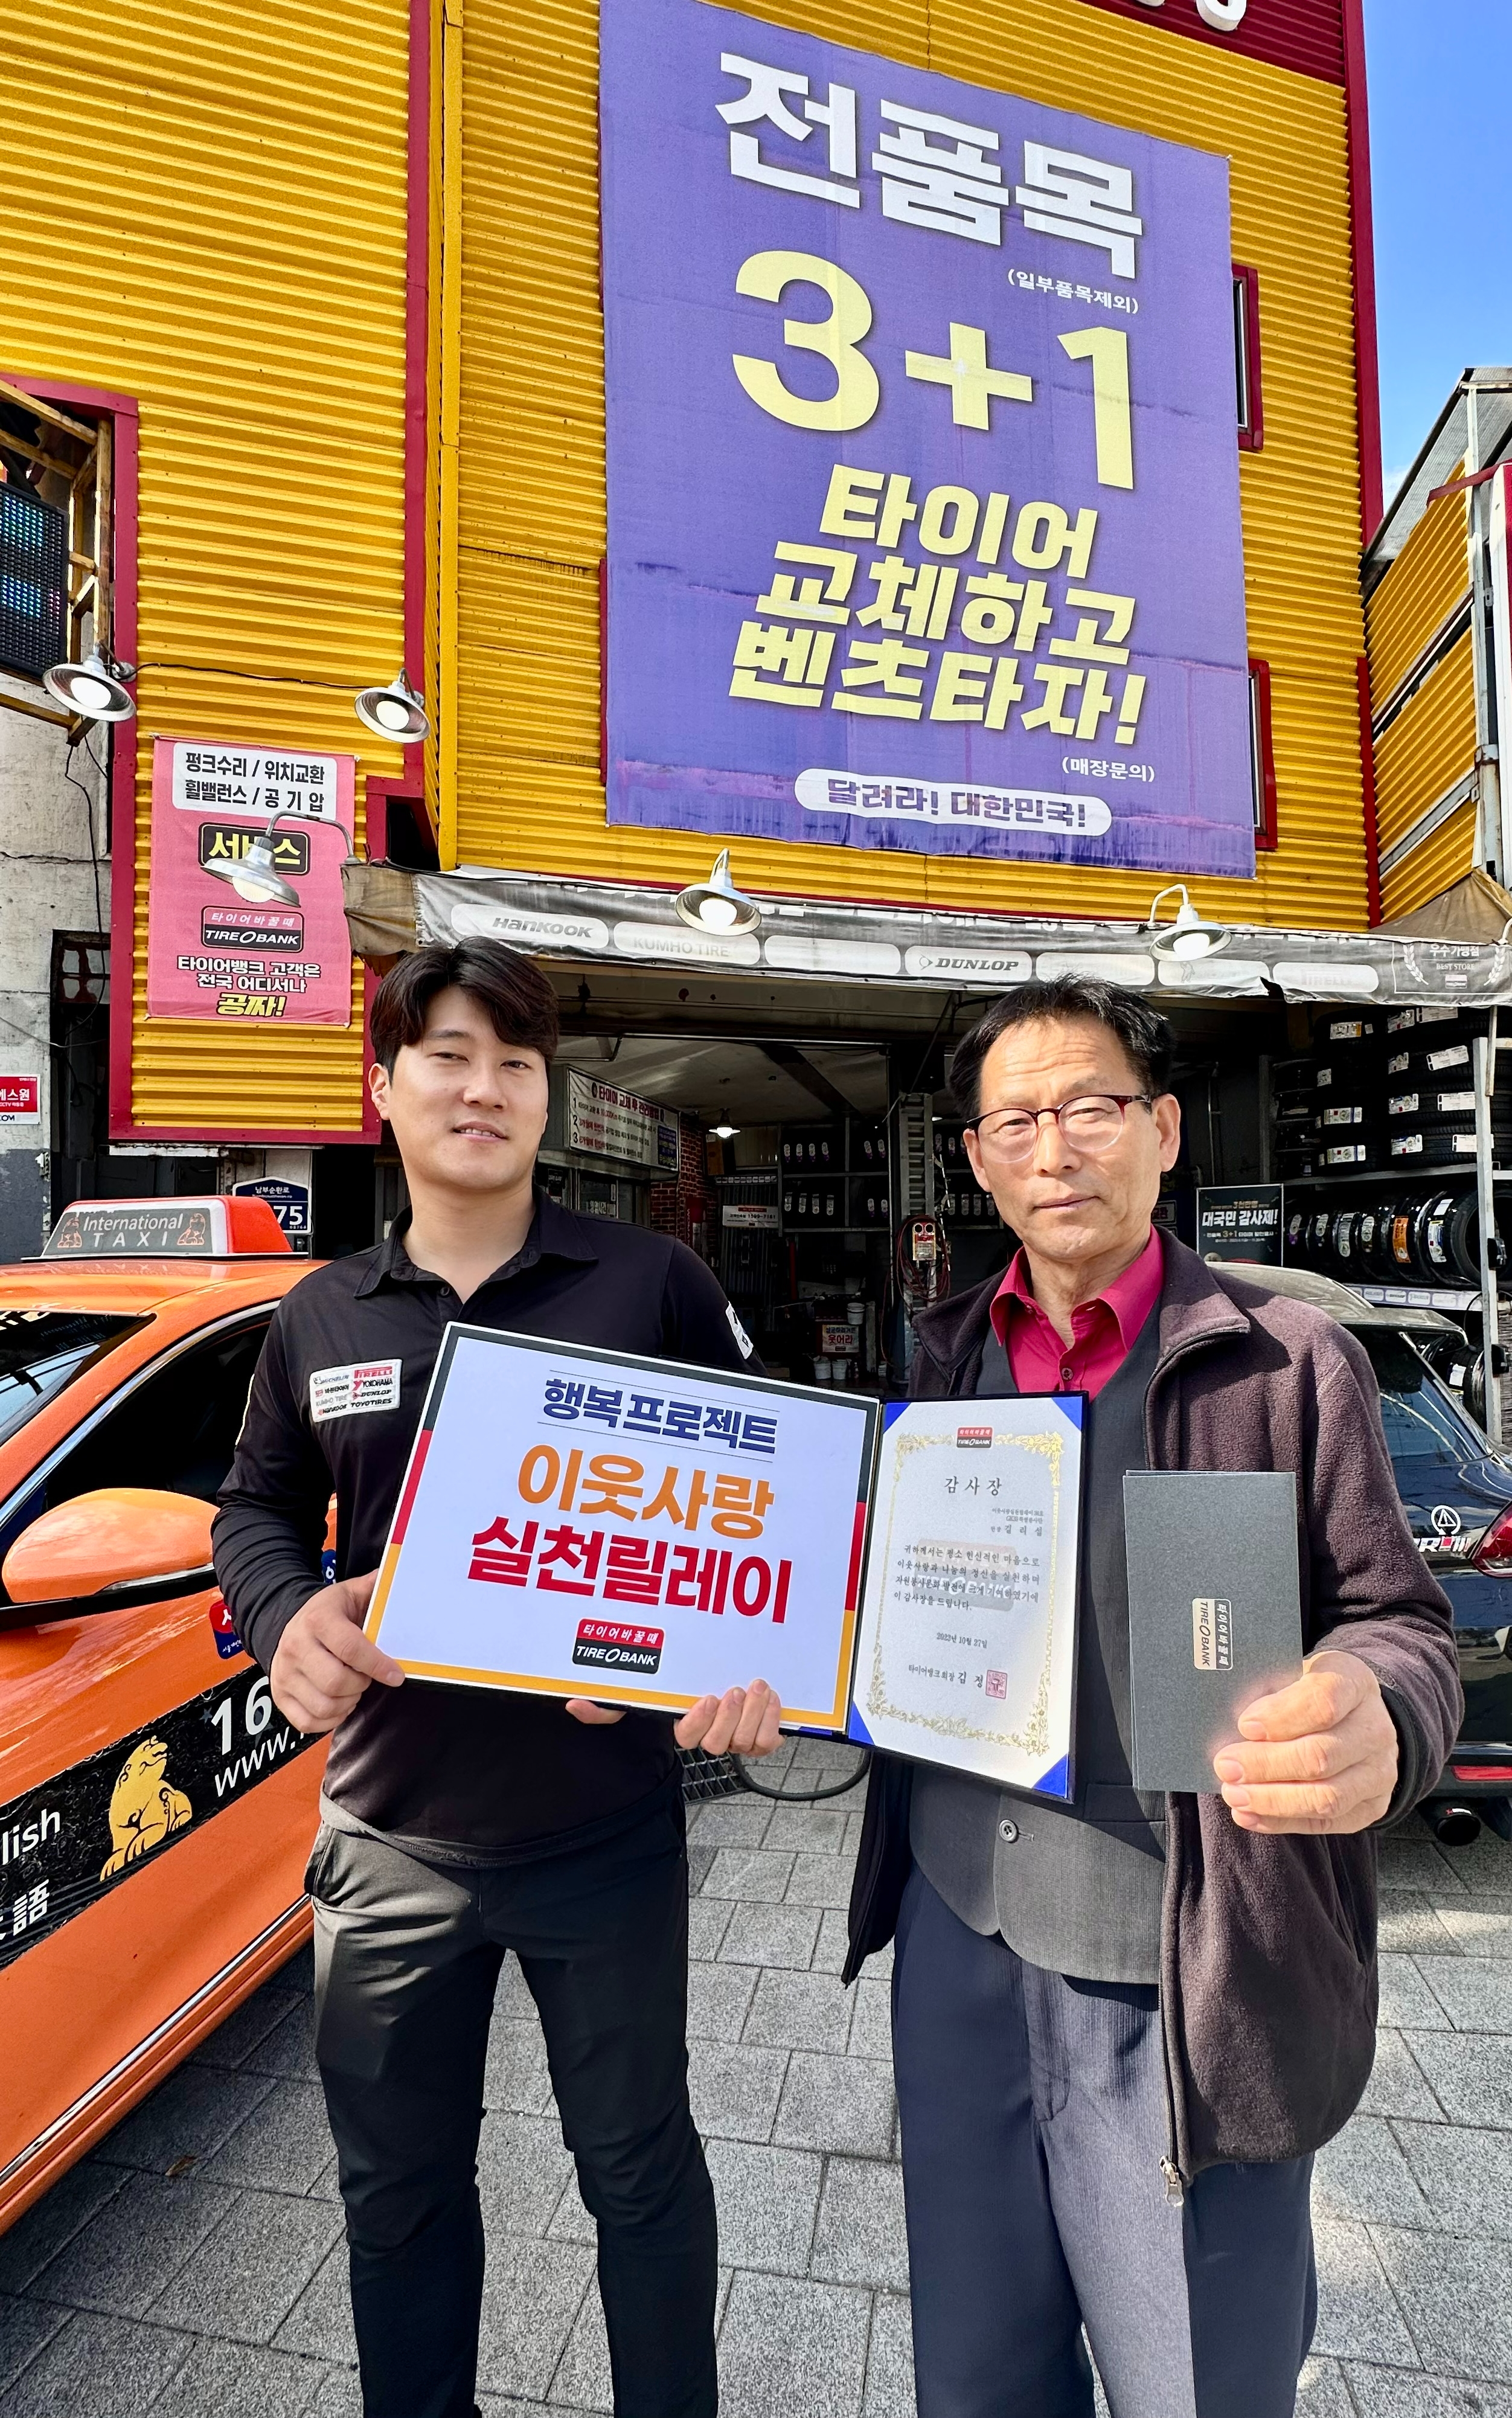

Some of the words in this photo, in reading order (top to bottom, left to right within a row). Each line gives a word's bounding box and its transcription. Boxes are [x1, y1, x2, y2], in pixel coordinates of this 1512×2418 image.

[715, 52, 1142, 278] 전품목
[1008, 269, 1138, 314] (일부품목제외)
[731, 250, 1133, 490] 3+1
[819, 463, 1098, 579] 타이어
[755, 540, 1135, 665] 교체하고
[729, 620, 1146, 744] 벤츠타자!
[186, 752, 247, 778] 펑크수리
[264, 763, 324, 785] 위치교환
[1062, 757, 1155, 783] (매장문의)
[185, 779, 247, 805] 휠밸런스
[827, 778, 938, 815] 달려라!
[951, 789, 1086, 827] 대한민국!
[209, 831, 302, 865] 서스
[633, 936, 693, 954] KUMHO
[697, 940, 729, 958] TIRE
[178, 956, 264, 975] 타이어뱅크
[270, 962, 321, 978] 고객은
[935, 957, 1019, 971] DUNLOP
[197, 973, 233, 990] 전국
[237, 976, 306, 994] 어디서나
[216, 992, 286, 1017] 공짜!
[83, 1213, 183, 1232] International
[1202, 1210, 1237, 1227] 대국민
[1238, 1209, 1278, 1227] 감사제!
[828, 1335, 853, 1344] 웃어라
[354, 1366, 392, 1379] PIRELLI
[362, 1377, 392, 1387] YOKOHAMA
[517, 1444, 775, 1539] 이웃사랑
[905, 1545, 943, 1557] 귀하께서는
[947, 1548, 962, 1559] 평소
[1004, 1555, 1040, 1567] 마음으로
[467, 1516, 792, 1624] 실천릴레이
[942, 1565, 966, 1576] 나눔의
[972, 1568, 996, 1580] 정신을
[1003, 1571, 1039, 1585] 실천하며
[904, 1592, 934, 1606] 감사장을
[214, 1726, 304, 1797] www.
